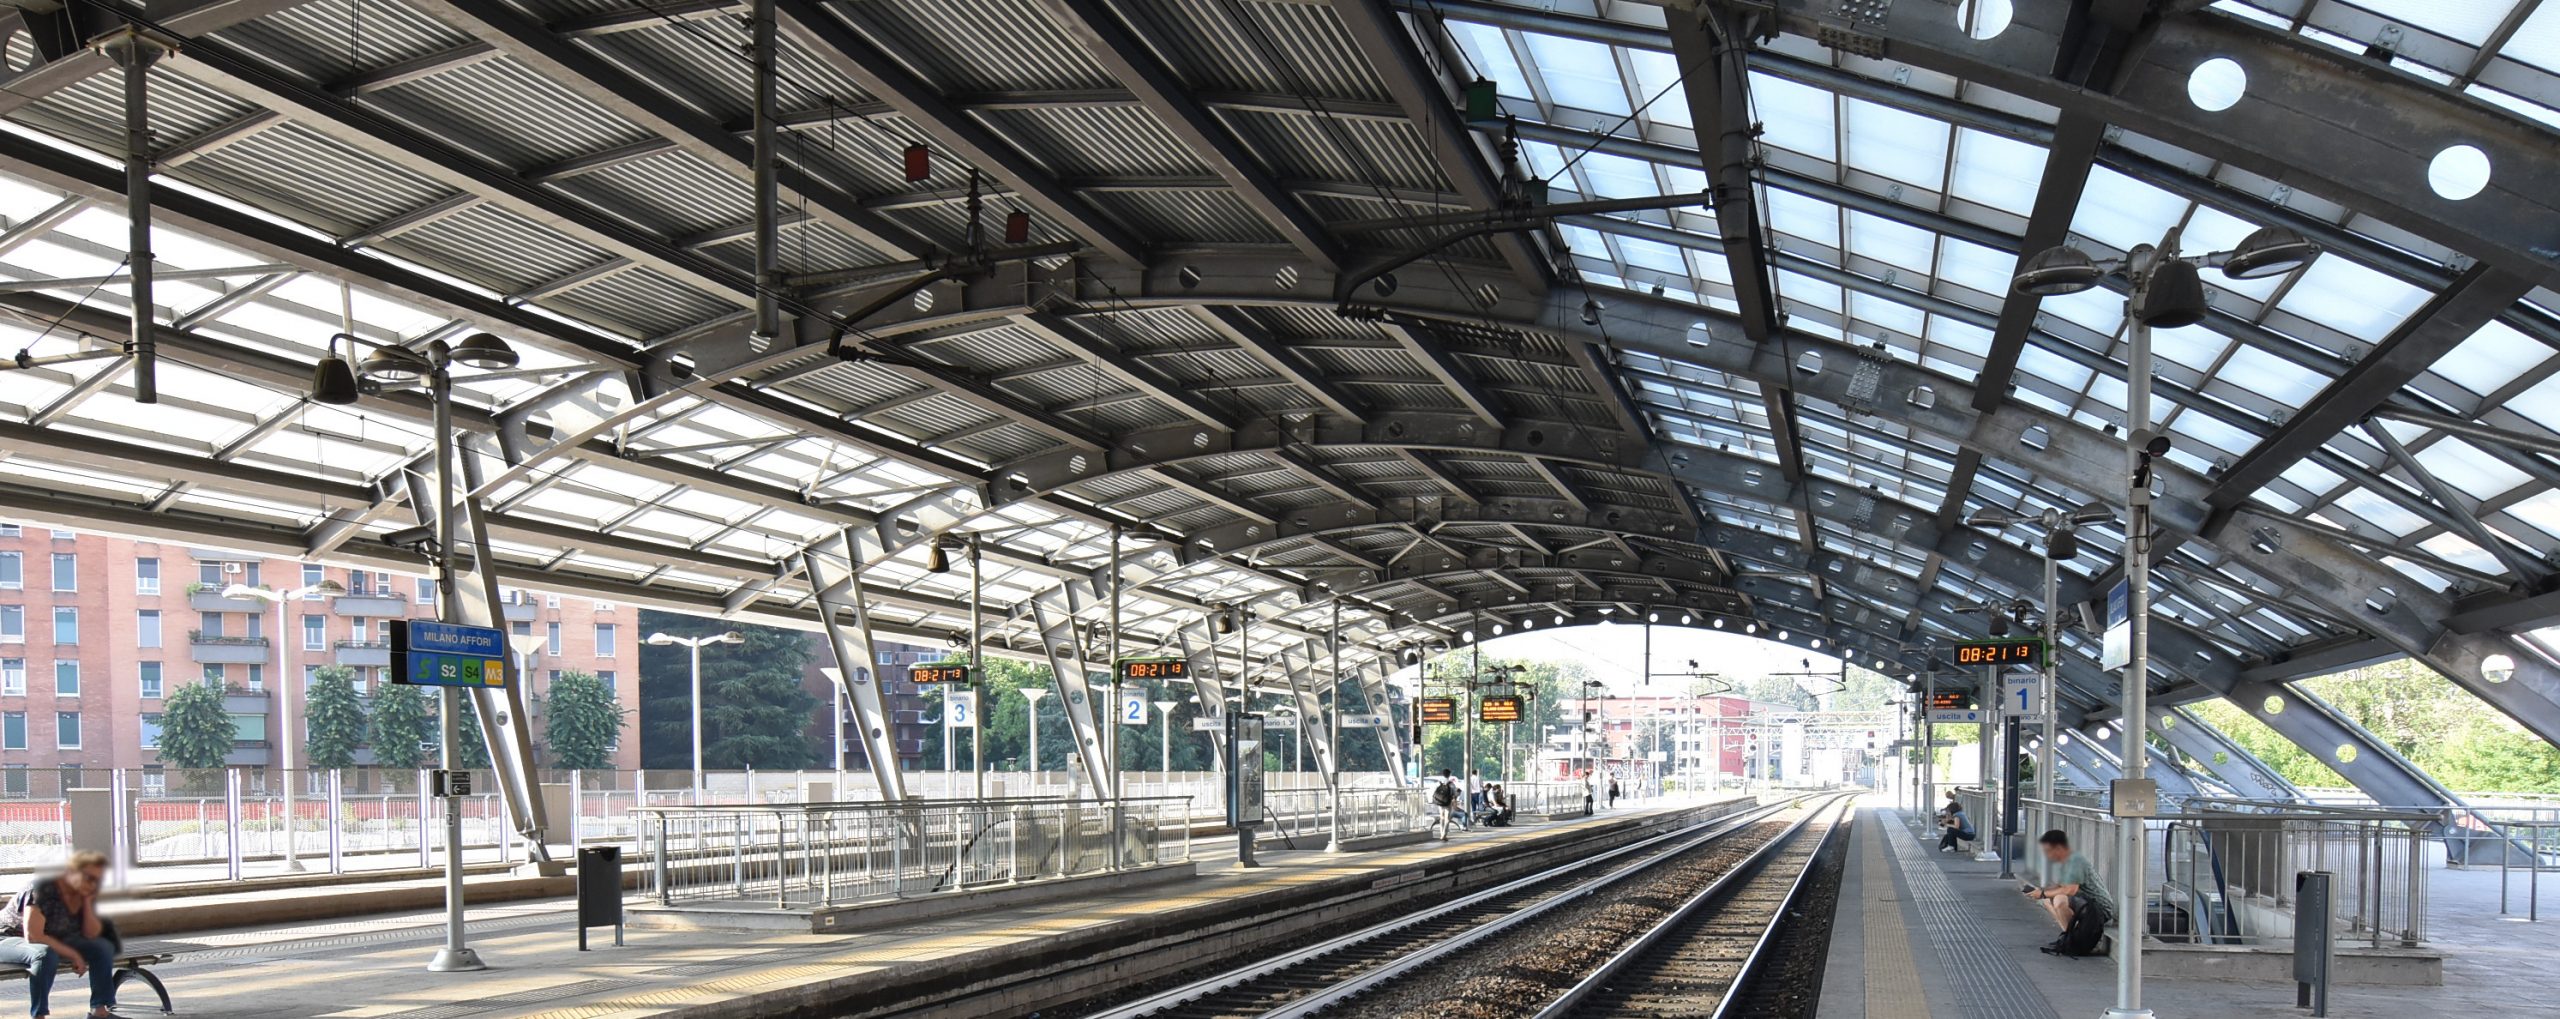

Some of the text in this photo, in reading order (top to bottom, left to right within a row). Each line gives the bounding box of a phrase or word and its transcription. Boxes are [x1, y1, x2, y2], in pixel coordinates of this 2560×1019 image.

[424, 631, 491, 646] MILANO AFFORI
[1959, 645, 2028, 662] 08:21 13
[441, 664, 456, 677] S2
[464, 666, 480, 678] S4
[485, 668, 503, 681] M3
[914, 669, 961, 682] 08:21 13
[1130, 664, 1181, 677] 08:21 13
[2007, 677, 2037, 685] binario
[2016, 687, 2028, 711] 1
[954, 703, 965, 722] 3
[1127, 700, 1140, 720] 2
[1936, 712, 1961, 720] uscita
